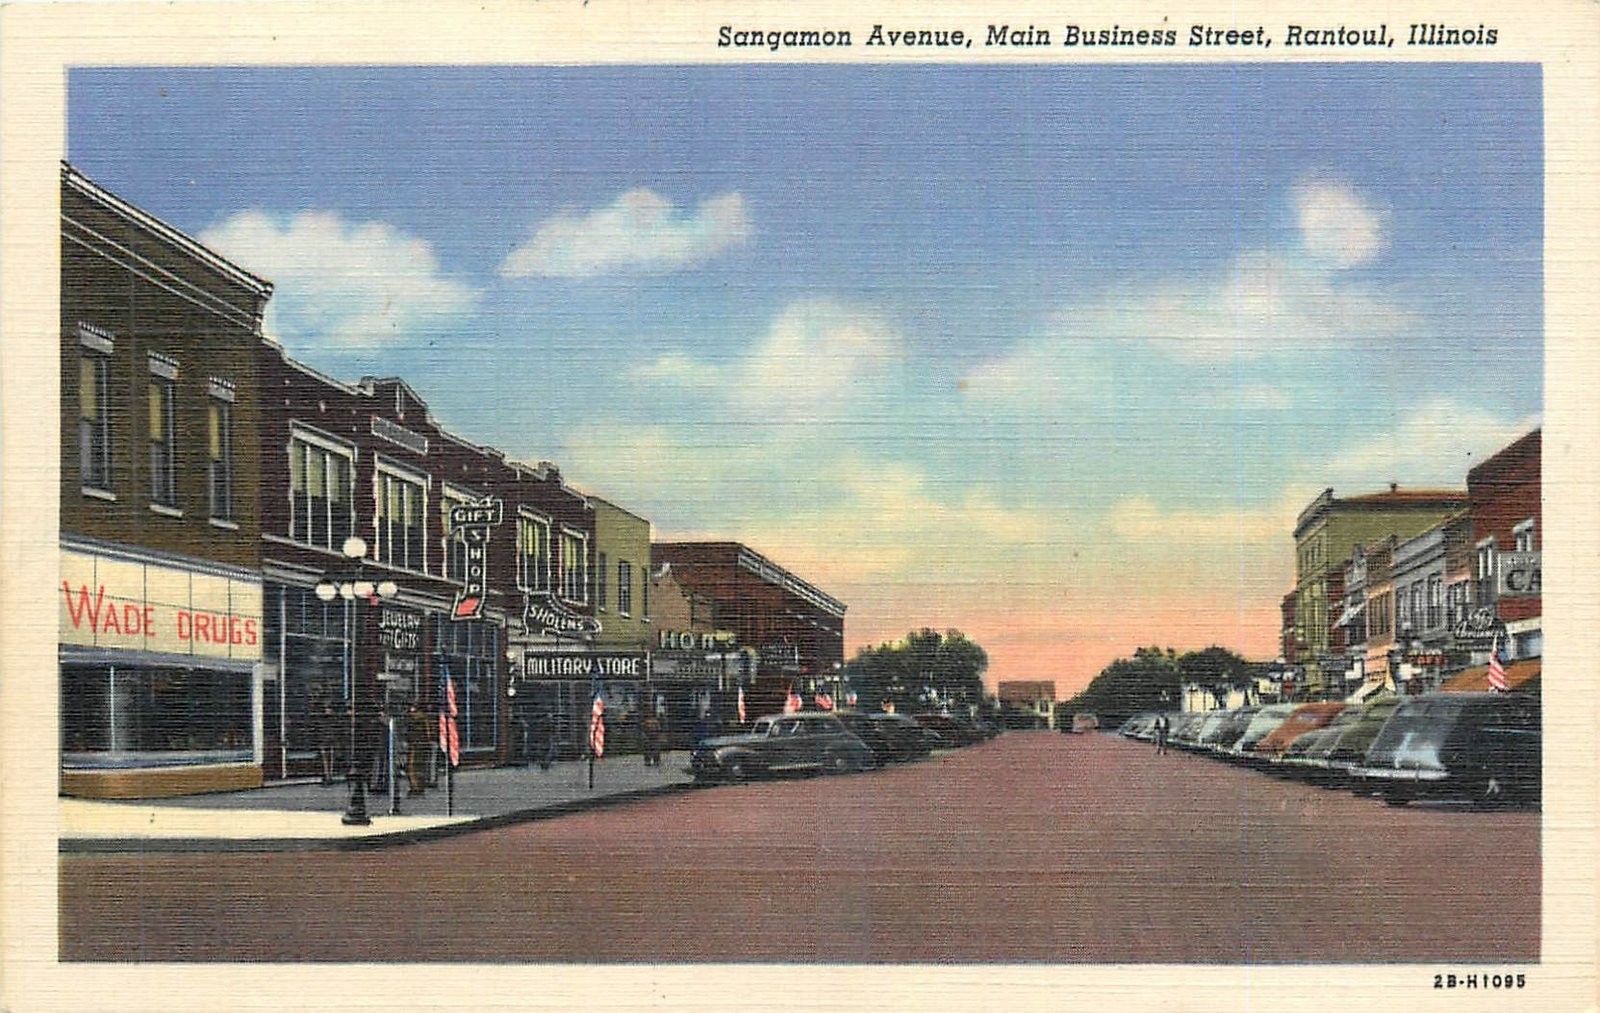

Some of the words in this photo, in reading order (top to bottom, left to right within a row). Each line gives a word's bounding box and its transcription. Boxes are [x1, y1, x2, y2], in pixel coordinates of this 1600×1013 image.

[454, 508, 496, 523] GIFT
[469, 529, 483, 594] SHOP
[62, 580, 157, 637] WADE
[177, 611, 257, 645] DRUGS
[527, 657, 592, 675] MILITARY
[597, 657, 641, 675] STORE
